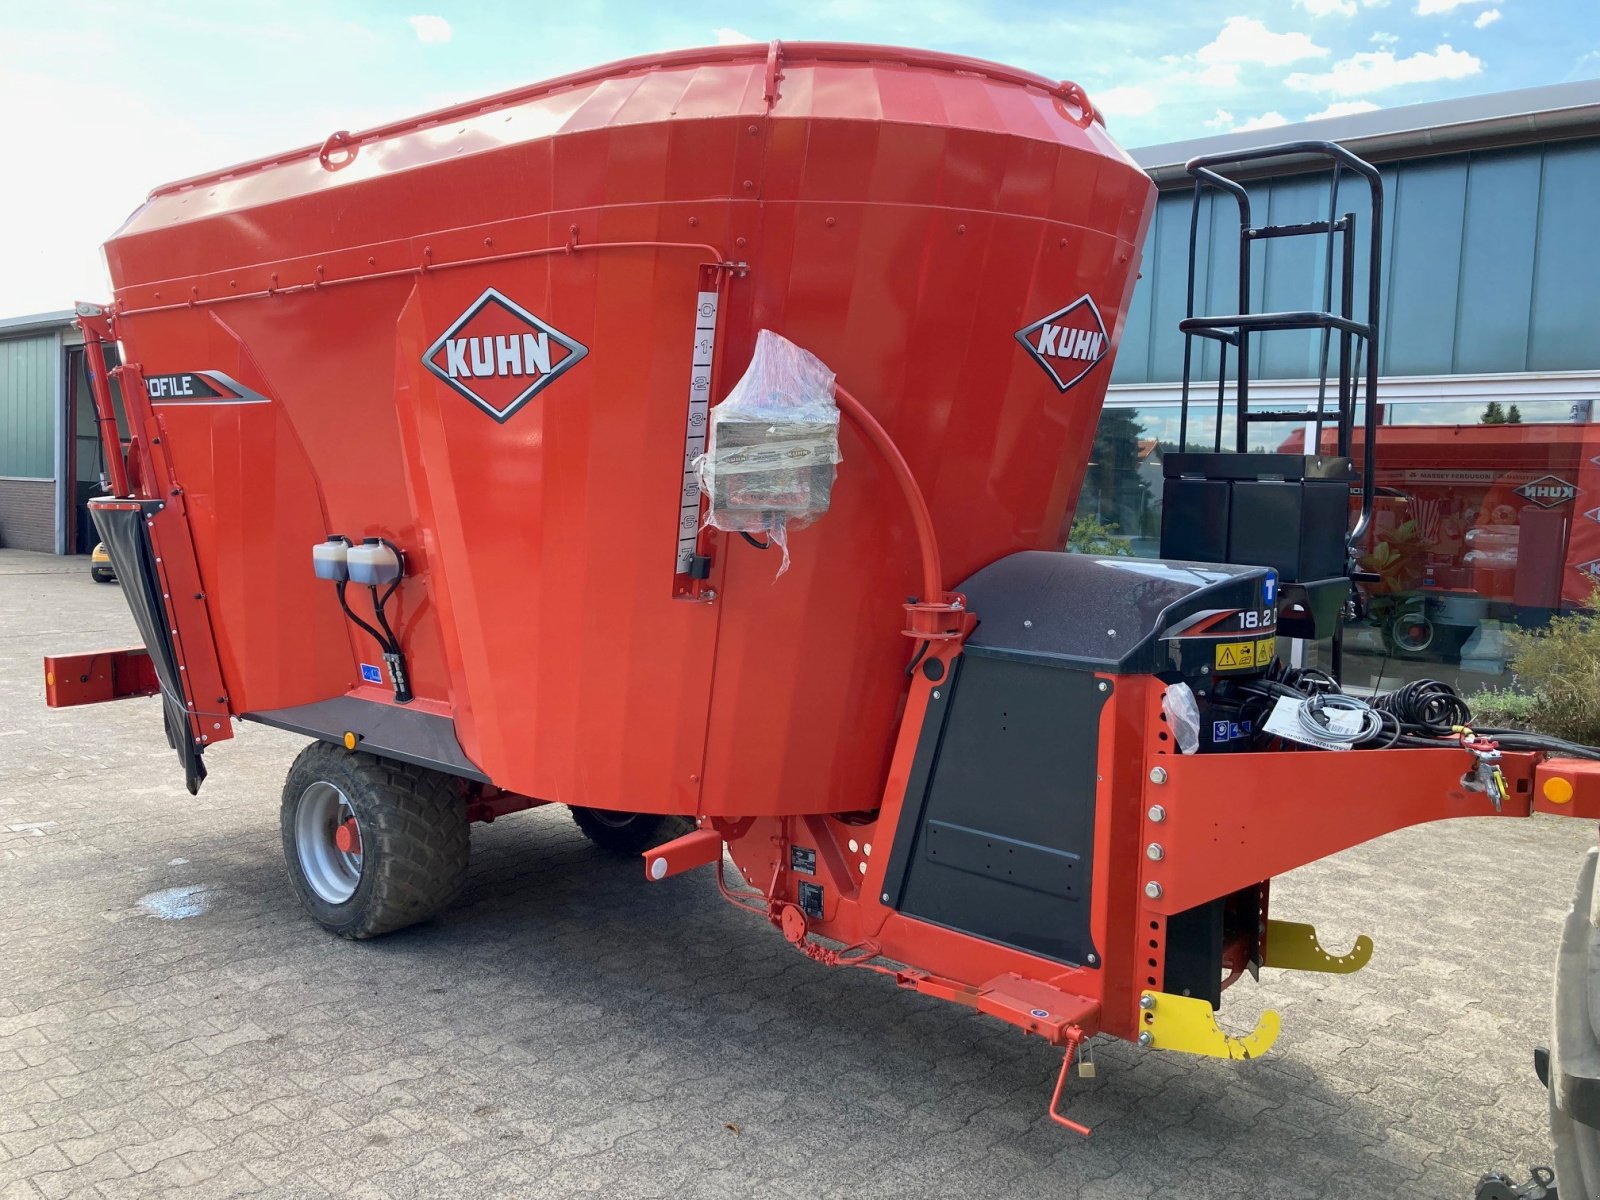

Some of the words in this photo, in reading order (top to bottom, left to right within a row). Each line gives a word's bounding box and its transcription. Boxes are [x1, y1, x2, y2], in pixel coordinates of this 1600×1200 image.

[700, 302, 714, 318] 0
[701, 339, 709, 354] 1
[1037, 323, 1104, 361] KUHN
[446, 332, 551, 378] KUHN
[693, 376, 707, 391] 2
[691, 412, 704, 427] 3
[685, 482, 698, 497] 5
[682, 514, 695, 529] 6
[681, 547, 692, 562] 7
[1238, 609, 1271, 629] 18.2
